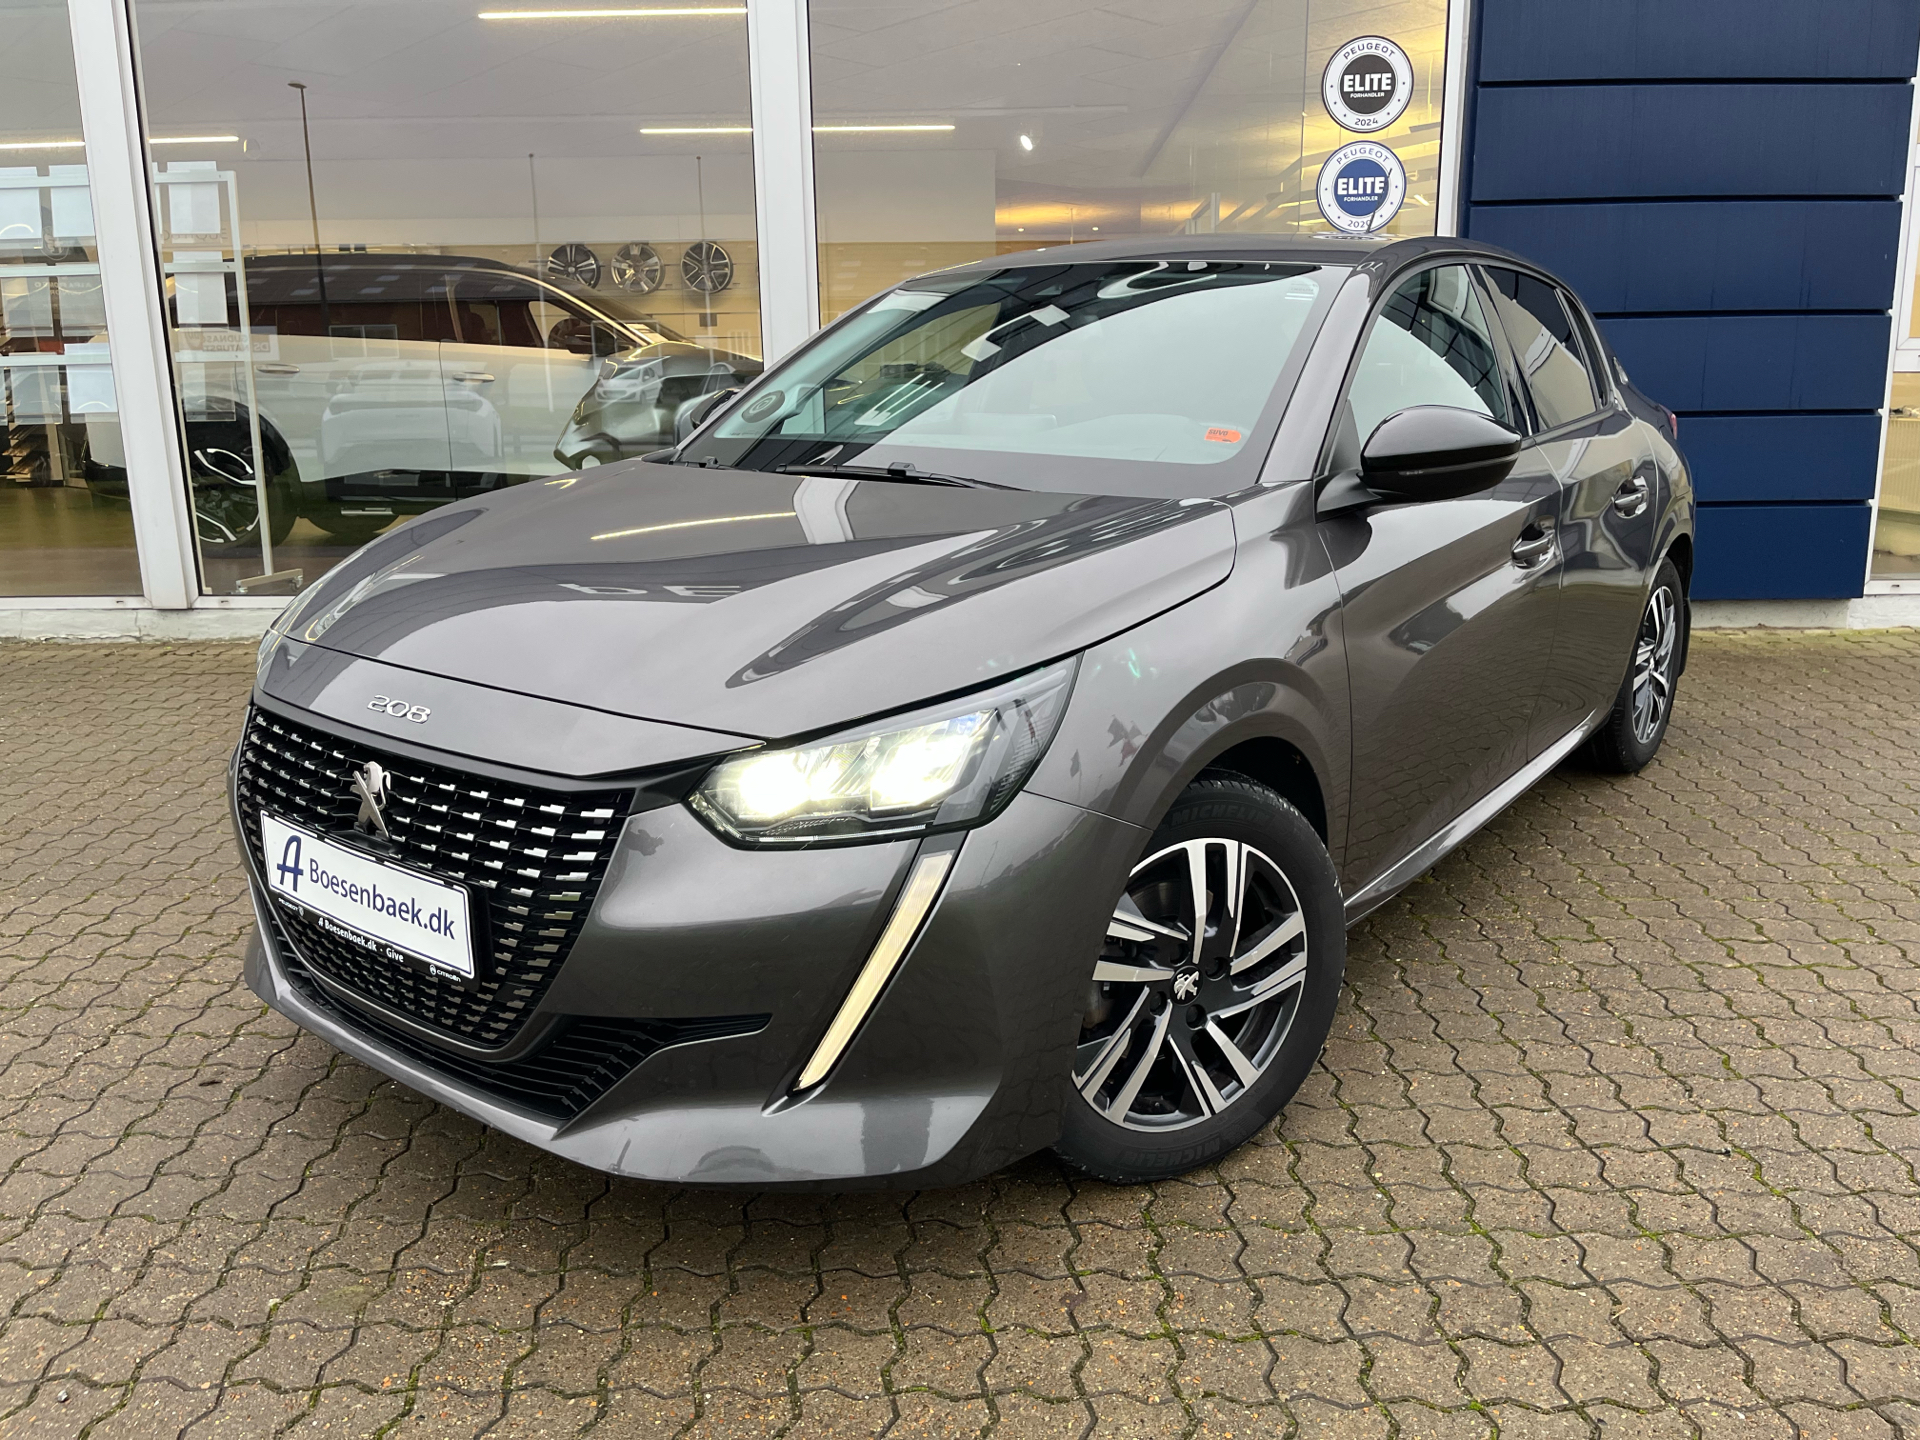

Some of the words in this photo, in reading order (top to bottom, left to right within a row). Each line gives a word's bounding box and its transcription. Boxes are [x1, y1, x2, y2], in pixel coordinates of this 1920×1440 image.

[1343, 42, 1396, 60] PEUGEOT
[1343, 72, 1392, 92] ELITE
[1354, 118, 1379, 127] 2024
[1336, 147, 1390, 165] PEUGEOT
[1337, 176, 1386, 195] ELITE
[367, 694, 432, 724] 208
[1171, 804, 1271, 827] MICHELIN
[309, 857, 456, 940] Boesenbaek.dk
[324, 920, 378, 952] Boesenbaek.dk
[386, 947, 404, 963] Give
